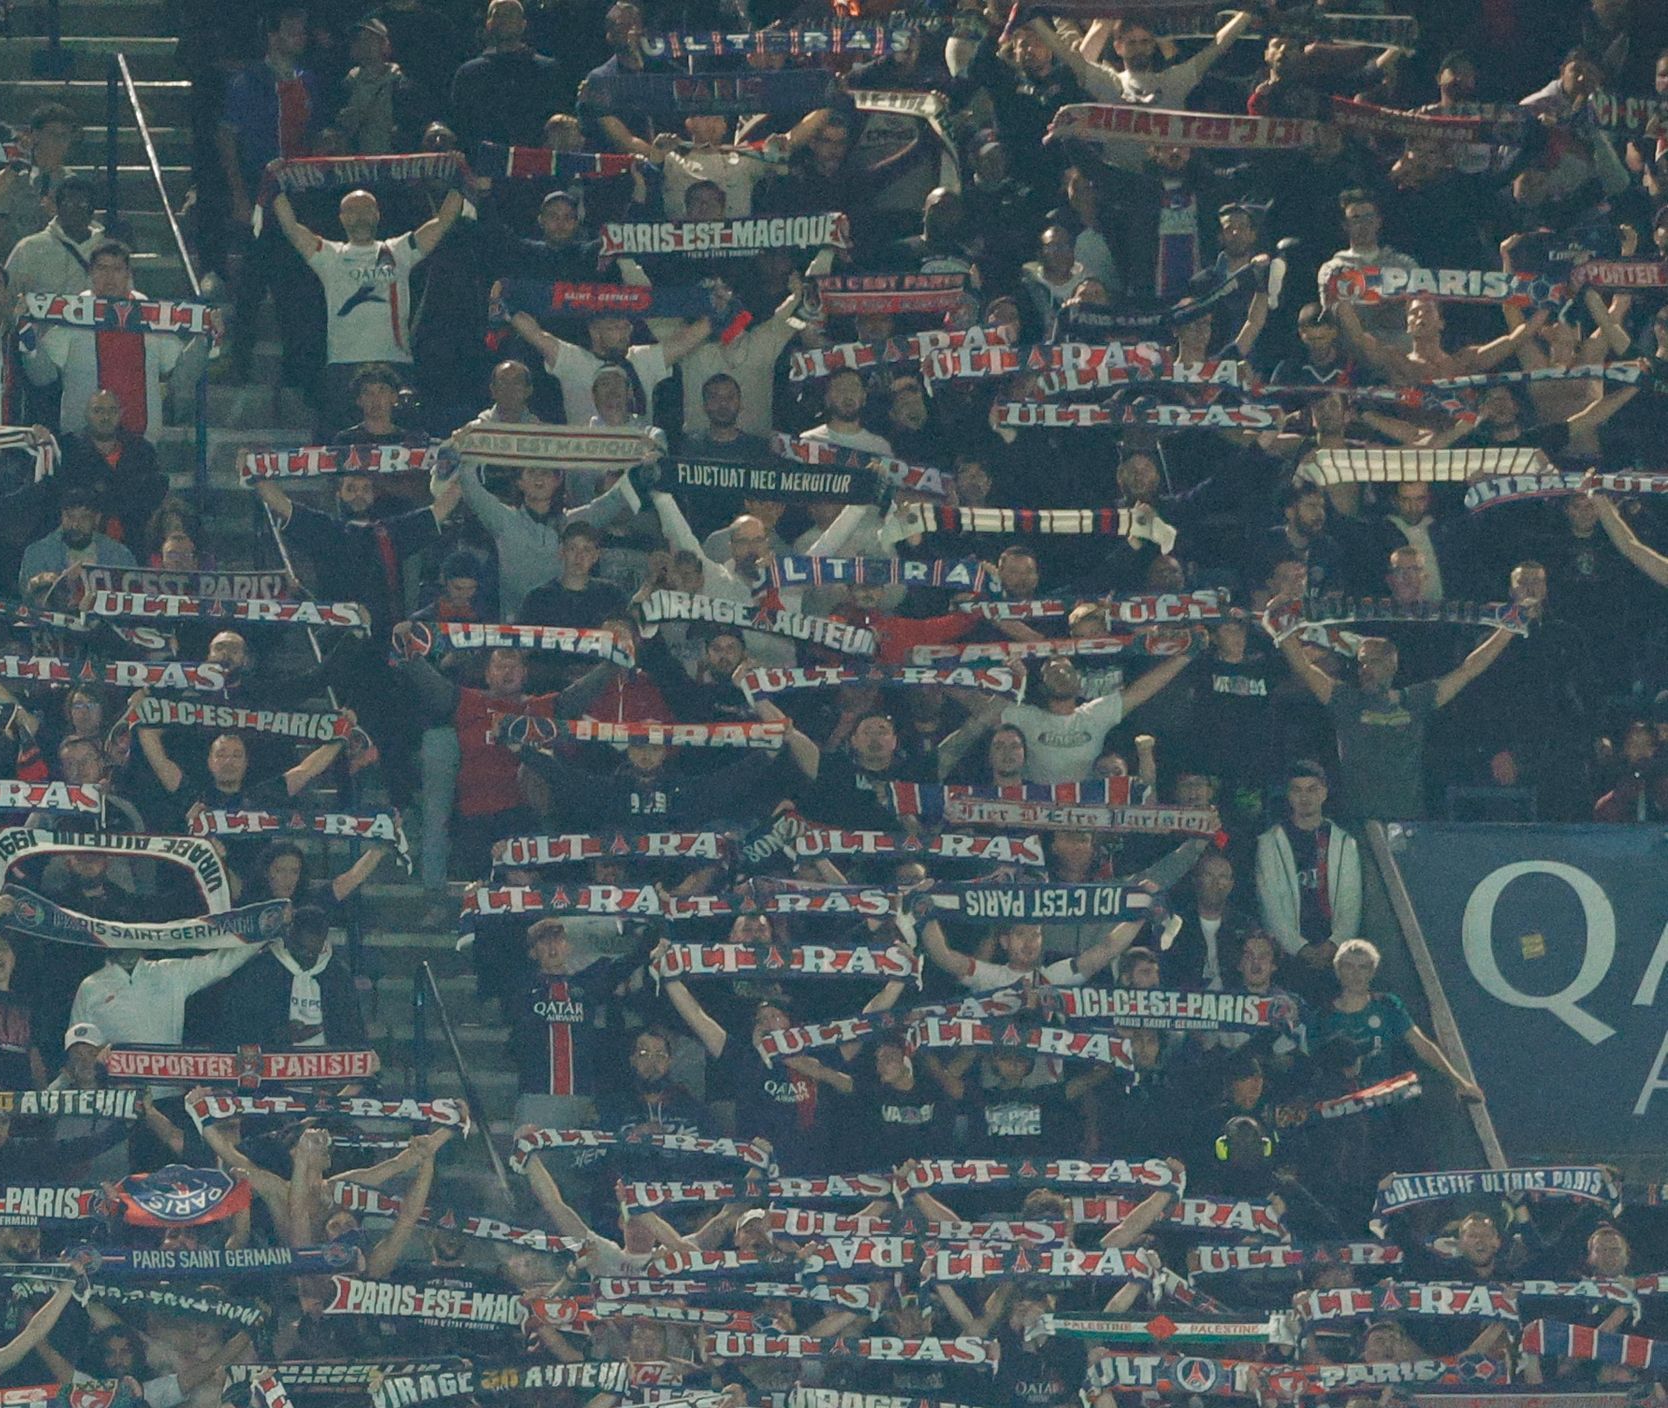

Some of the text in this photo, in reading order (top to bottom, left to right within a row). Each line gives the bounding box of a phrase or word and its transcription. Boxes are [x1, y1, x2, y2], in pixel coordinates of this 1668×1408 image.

[607, 216, 839, 253] PARIS EST MAGIQUE
[1383, 269, 1508, 297] PARIS
[677, 467, 852, 494] FLUCTUAT NEC MERGITUR
[140, 698, 336, 740] ICI C'EST PARIS
[964, 888, 1123, 916] ICI C'EST PARIS
[534, 1001, 583, 1015] QATAR
[1072, 988, 1259, 1023] ICI C'EST PARIS
[109, 1051, 234, 1078] SUPPORTER
[19, 1089, 140, 1118] AUTEUIL
[1481, 1171, 1545, 1195] ULTRAS
[1550, 1169, 1602, 1193] PARIS
[12, 1186, 82, 1220] PARIS
[133, 1247, 291, 1269] PARIS SAINT GERMAIN
[347, 1283, 464, 1316] PARIS EST
[1322, 1362, 1445, 1387] PARIS
